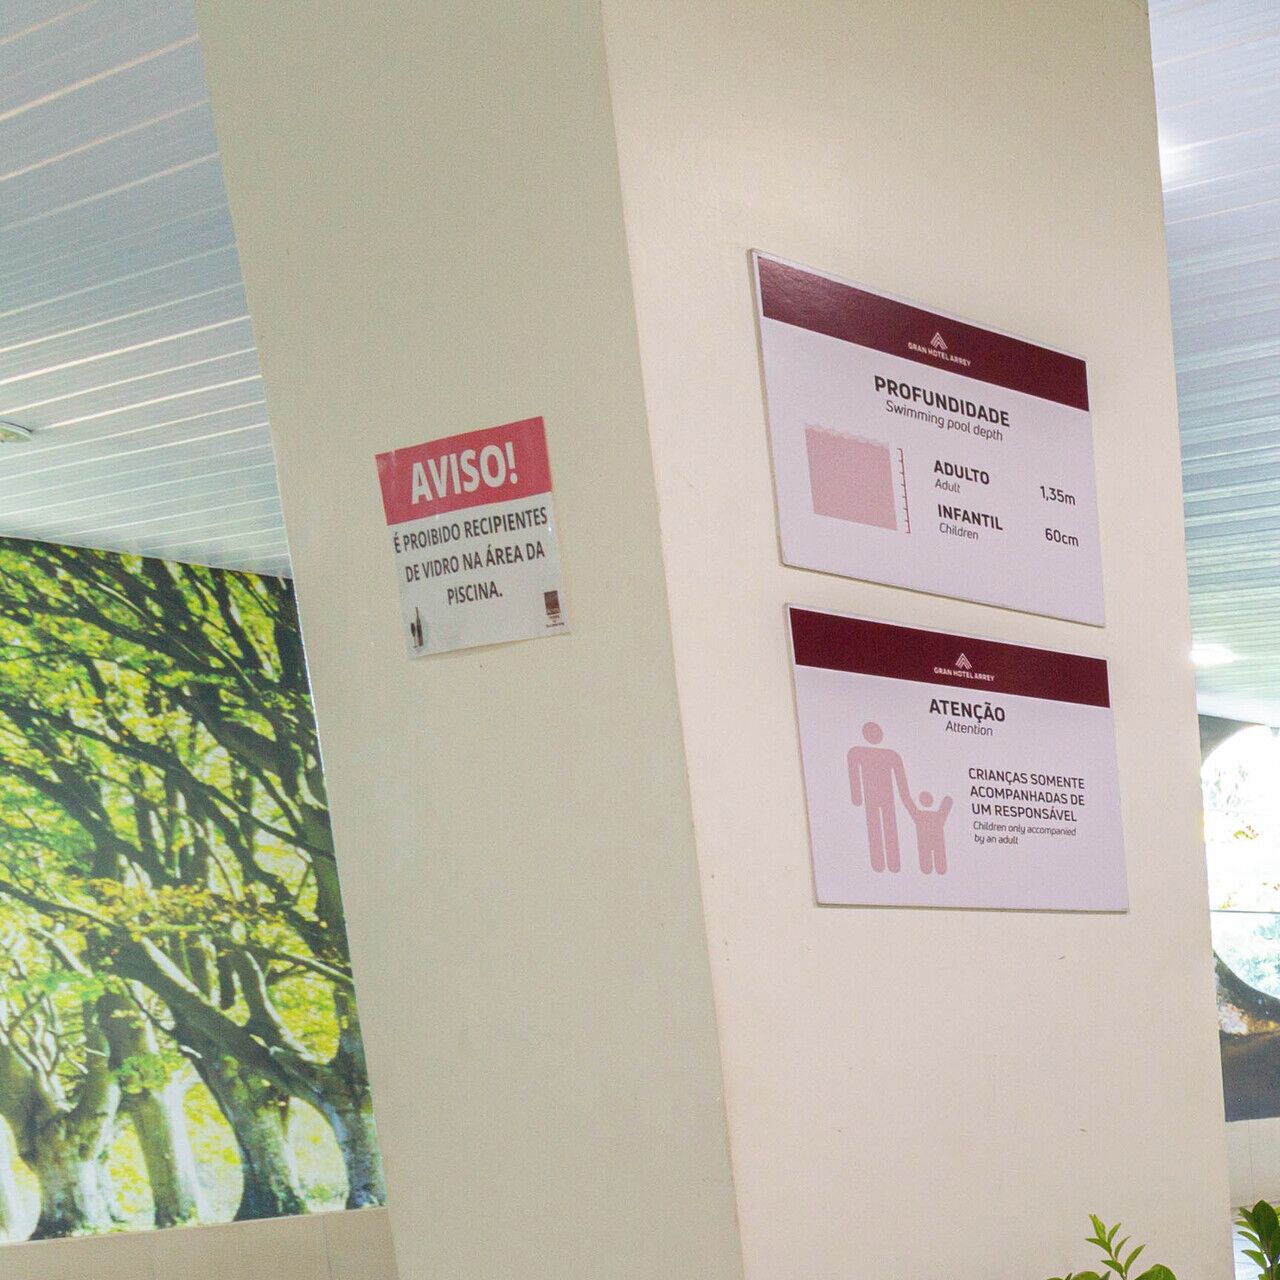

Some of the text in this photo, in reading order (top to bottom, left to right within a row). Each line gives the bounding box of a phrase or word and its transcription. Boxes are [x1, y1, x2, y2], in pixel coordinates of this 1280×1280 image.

[908, 342, 971, 367] GRAN HOTEL ARREY
[874, 375, 1010, 427] PROFUNDIDADE
[886, 400, 1003, 441] Swimming pool depth
[412, 441, 518, 504] AVISO!
[933, 459, 990, 485] ADULTO
[934, 478, 961, 494] Adult
[1039, 485, 1076, 506] 1,35m
[937, 504, 1003, 531] INFANTIL
[393, 507, 548, 553] É PROIBIDO RECIPIENTES
[939, 522, 979, 541] Children
[1045, 528, 1079, 547] 60cm
[405, 541, 545, 583] DE VIDRO NA ÁREA DA
[447, 581, 503, 605] PISCINA.
[933, 666, 995, 681] GRAN HOTEL ARREY
[929, 698, 1005, 723] ATENÇÃO
[945, 720, 993, 736] Attention
[968, 767, 1085, 789] CRIANÇAS SOMENTE
[970, 785, 1085, 806] ACOMPANHADAS DE
[971, 803, 1077, 822] UM RESPONSÁVEL
[973, 820, 1077, 837] Children only accompanied
[974, 834, 1018, 845] by an adult
